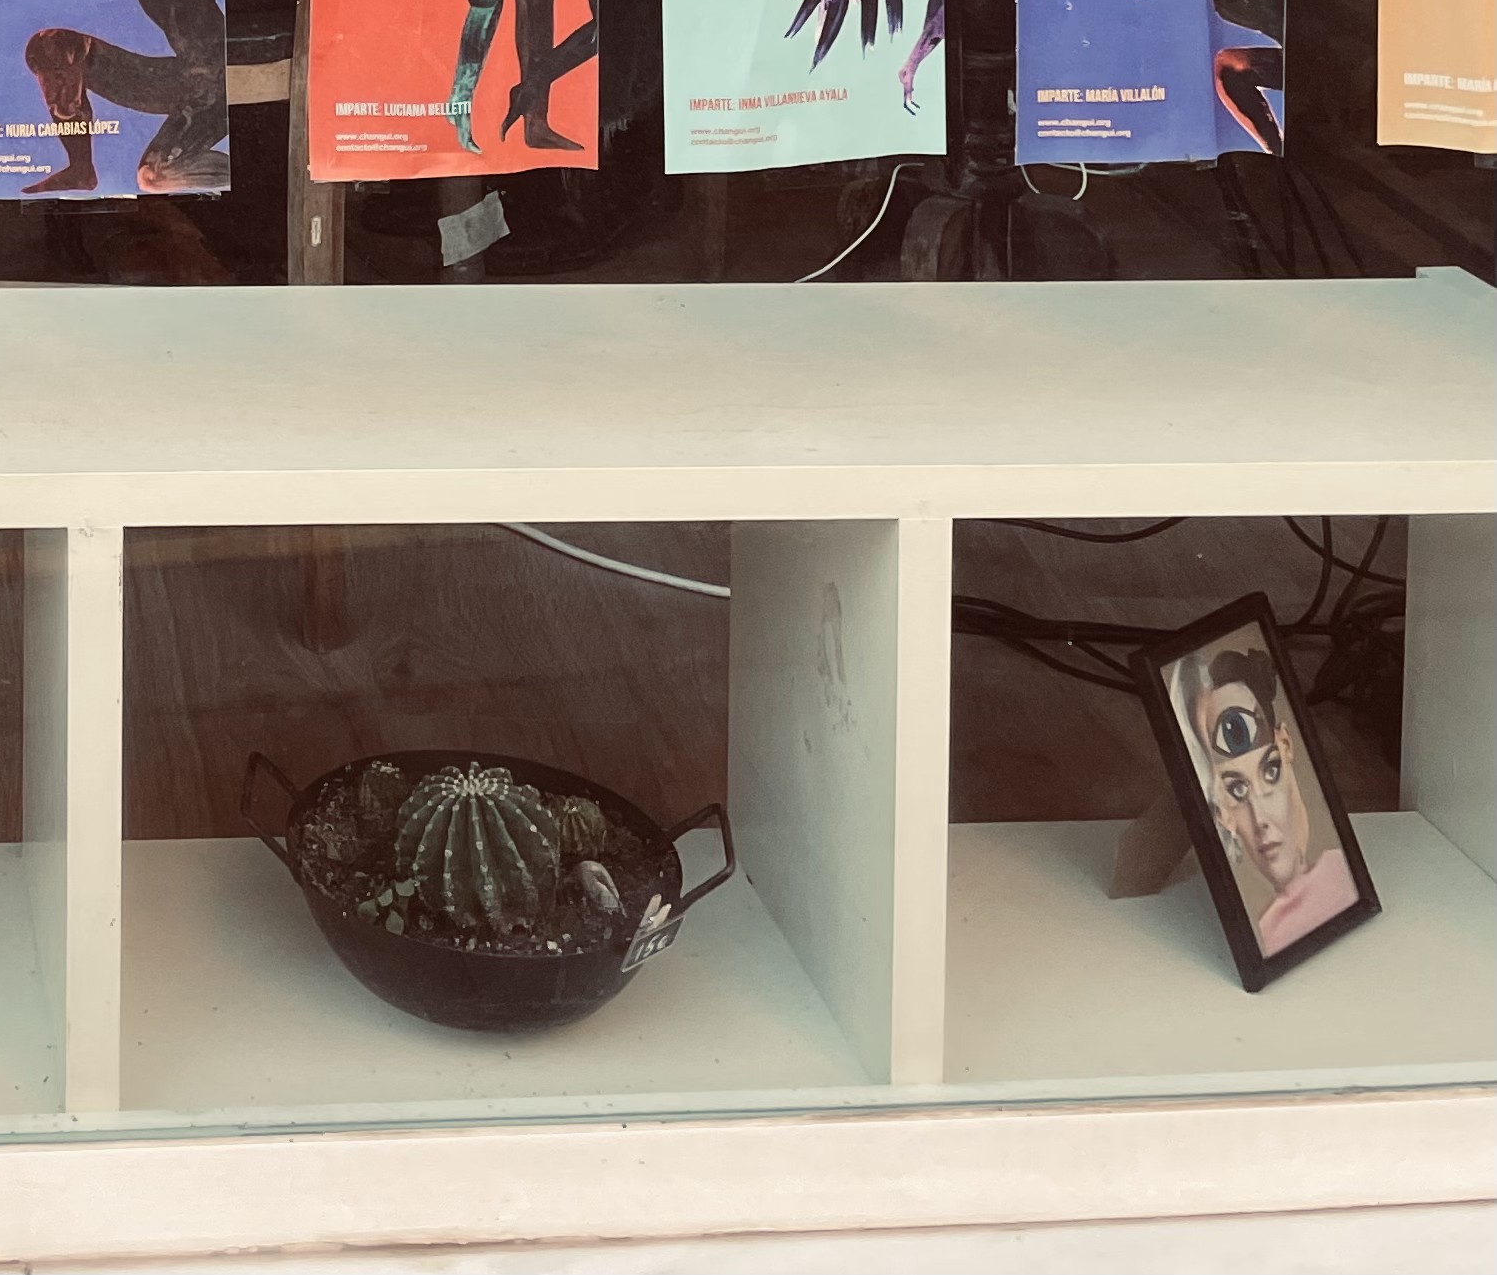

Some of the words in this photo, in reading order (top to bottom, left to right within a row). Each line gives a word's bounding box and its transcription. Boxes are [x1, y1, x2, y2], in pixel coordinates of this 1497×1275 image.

[738, 97, 762, 111] INMA
[764, 90, 817, 108] VILLANUEVA
[819, 88, 848, 101] AYALA
[1085, 86, 1119, 103] MARÍA
[1120, 85, 1166, 102] VILLALÓN
[384, 102, 426, 117] LUCIANA
[427, 100, 471, 117] BELLETTI
[5, 123, 36, 138] NURIA
[37, 121, 88, 137] CARABIAS
[88, 119, 120, 135] LÓPEZ
